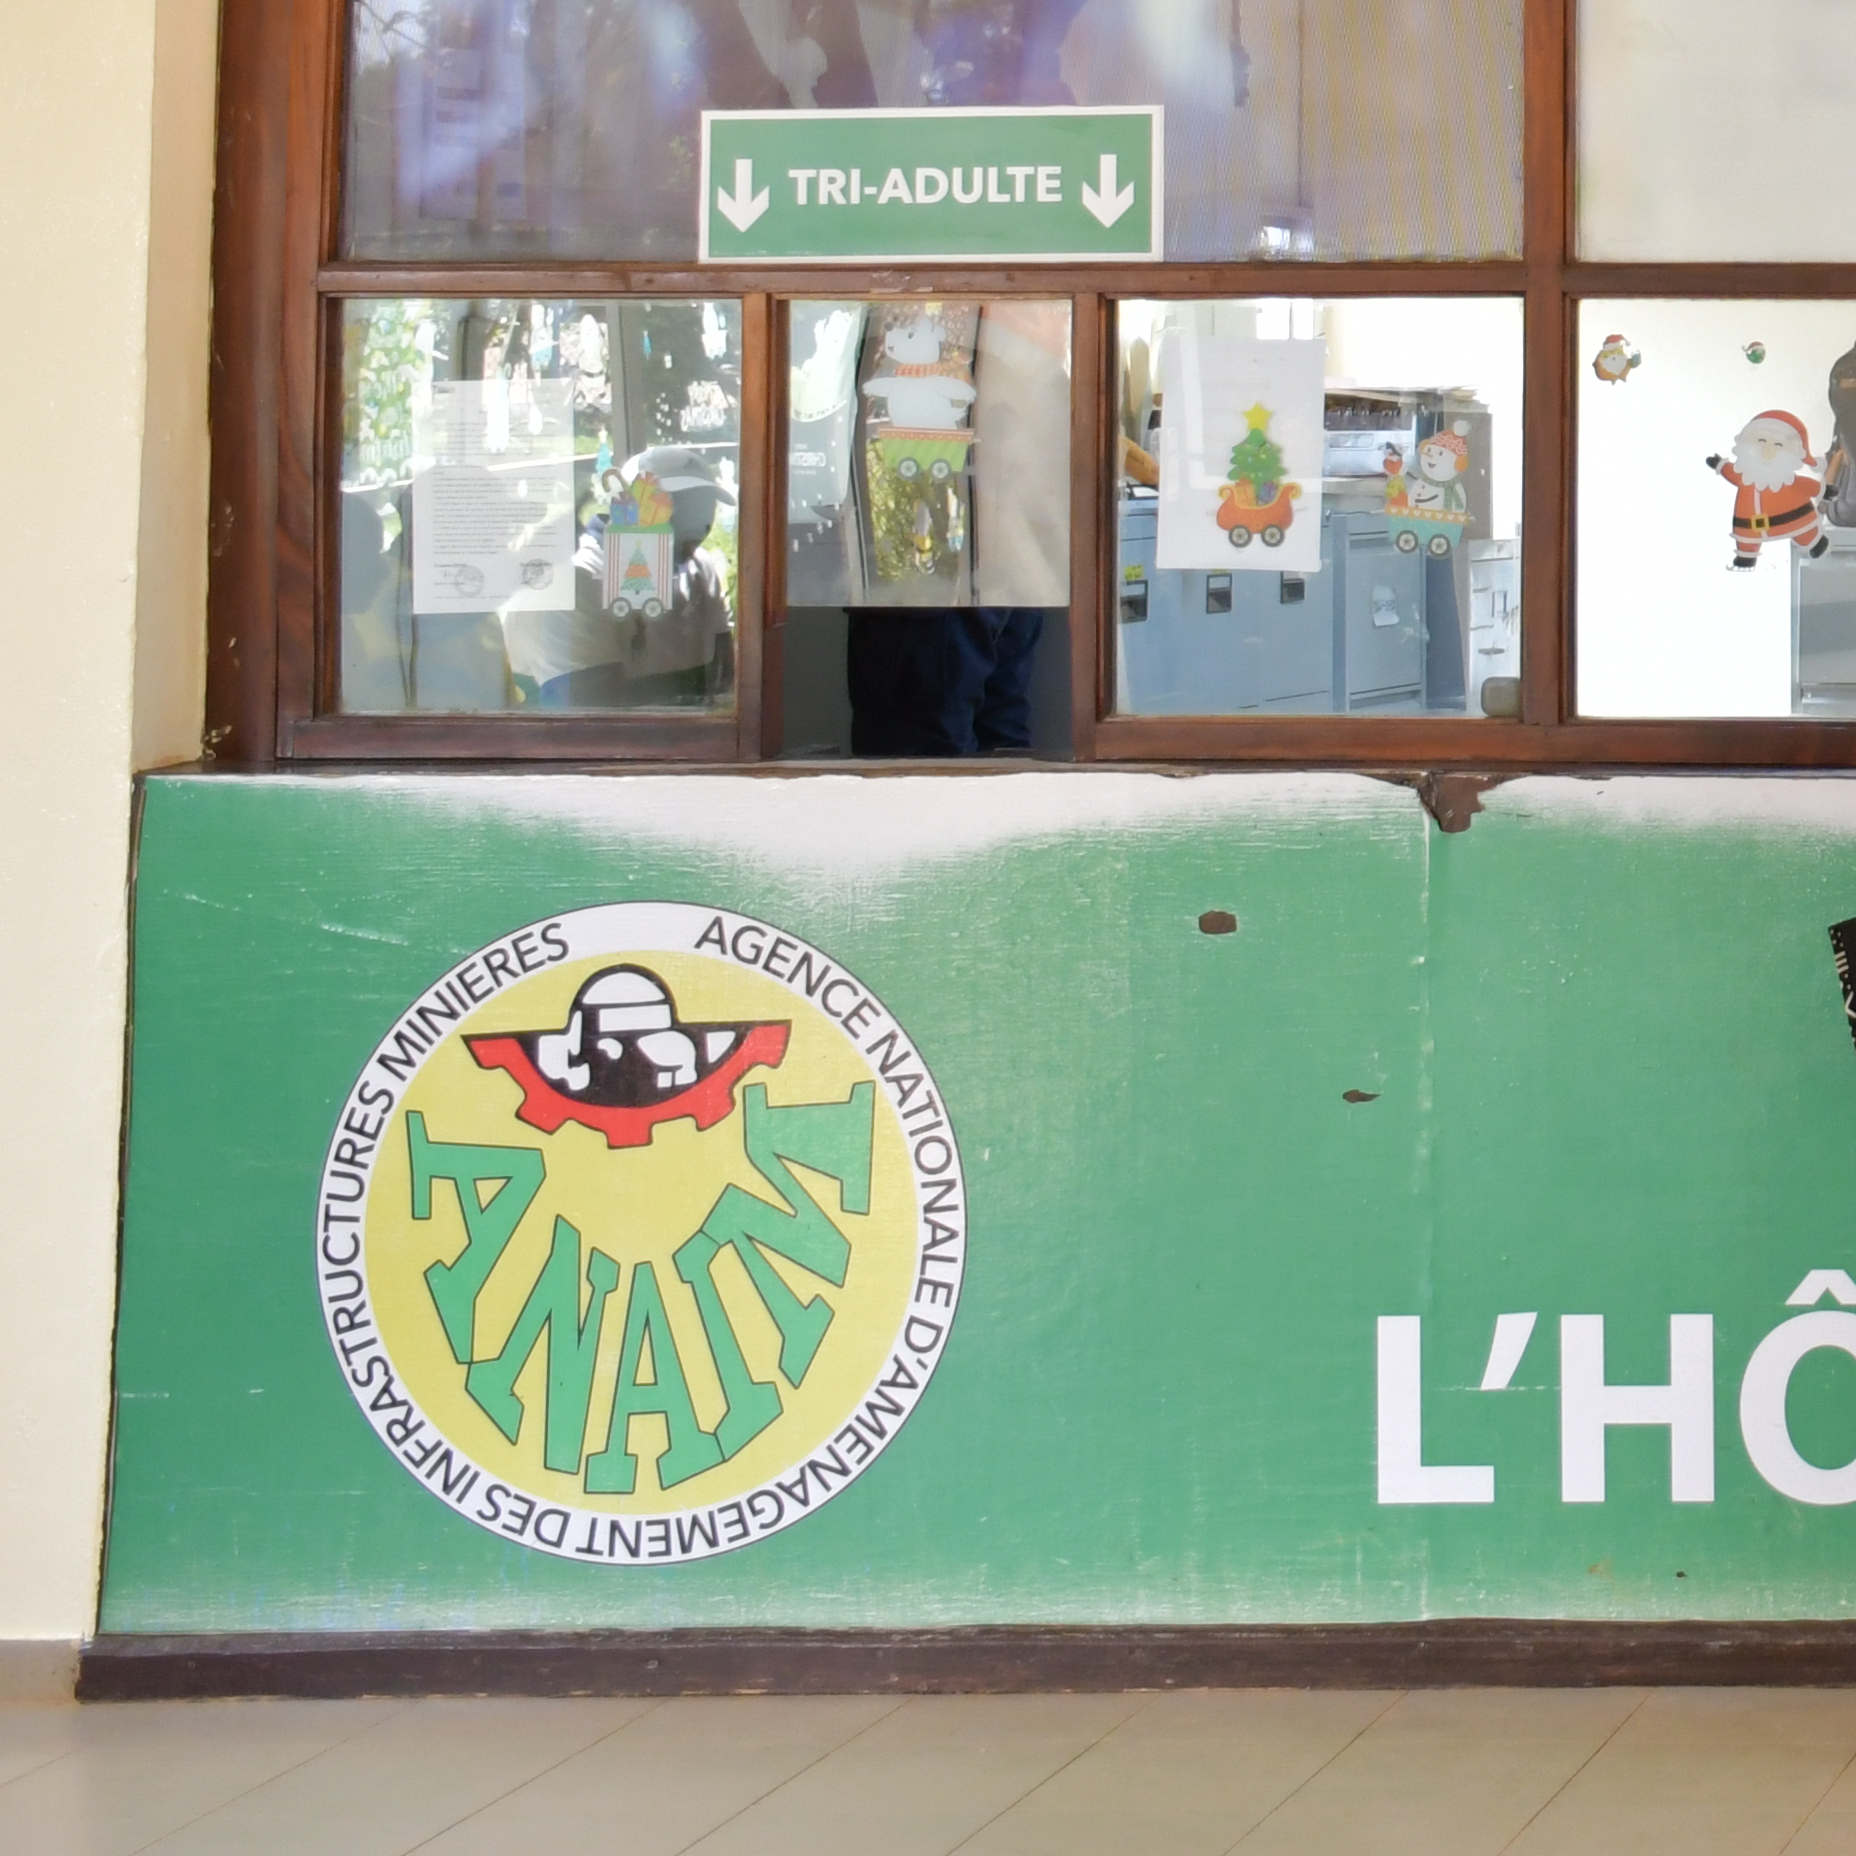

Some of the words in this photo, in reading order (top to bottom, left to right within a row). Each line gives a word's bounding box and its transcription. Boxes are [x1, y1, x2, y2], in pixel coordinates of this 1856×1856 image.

[787, 165, 1063, 206] TRI-ADULTE
[379, 922, 570, 1082] MINIERES
[694, 915, 882, 1039] AGENCE
[865, 1030, 962, 1309] NATIONALE
[322, 1080, 482, 1501] INFRASTRUCTURES
[405, 1080, 876, 1495] ANAIM
[477, 1481, 571, 1546] DES
[574, 1321, 943, 1559] D'AMENAGEMENT
